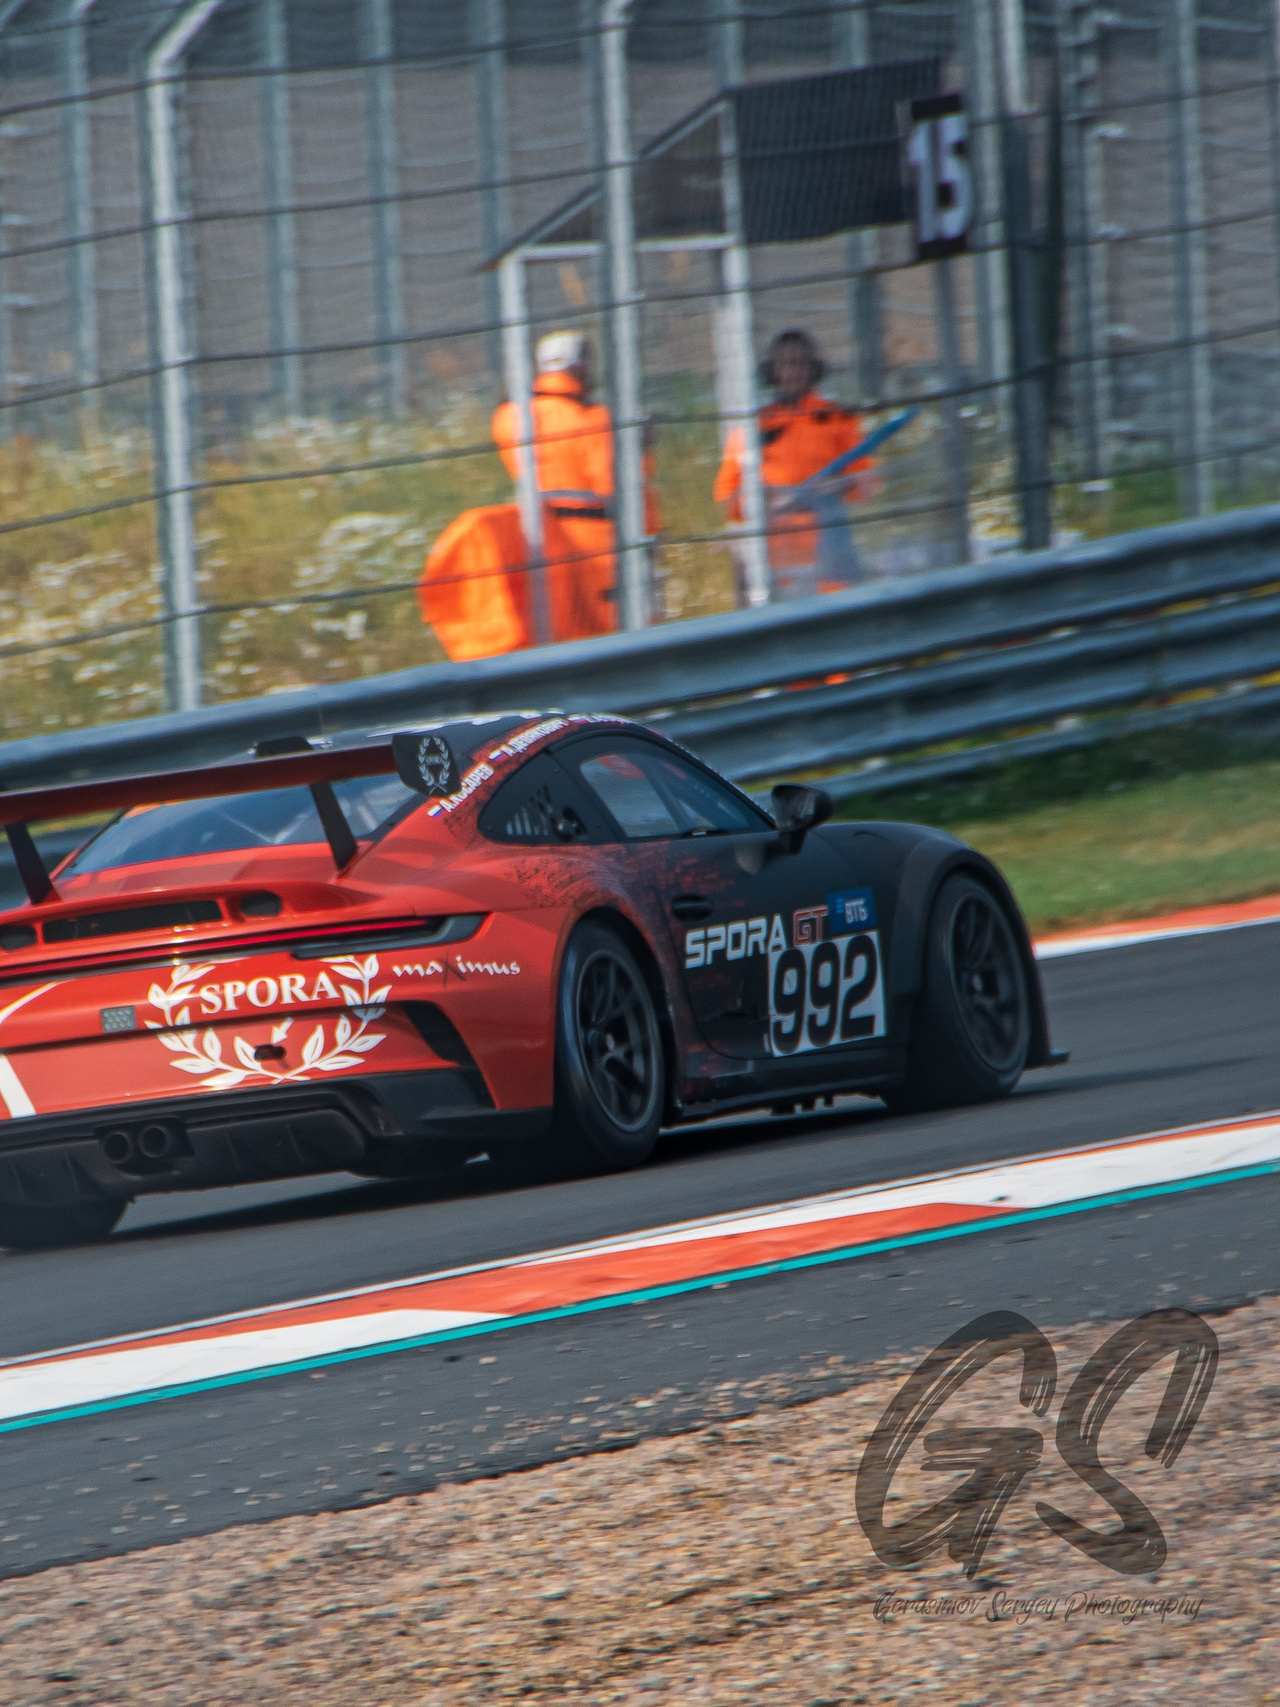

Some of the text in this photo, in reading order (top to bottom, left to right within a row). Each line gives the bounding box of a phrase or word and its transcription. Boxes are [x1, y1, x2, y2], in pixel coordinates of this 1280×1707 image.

[907, 114, 971, 243] 15
[685, 904, 829, 969] SPORA GT
[199, 971, 342, 1015] SPORA
[772, 934, 877, 1055] 992
